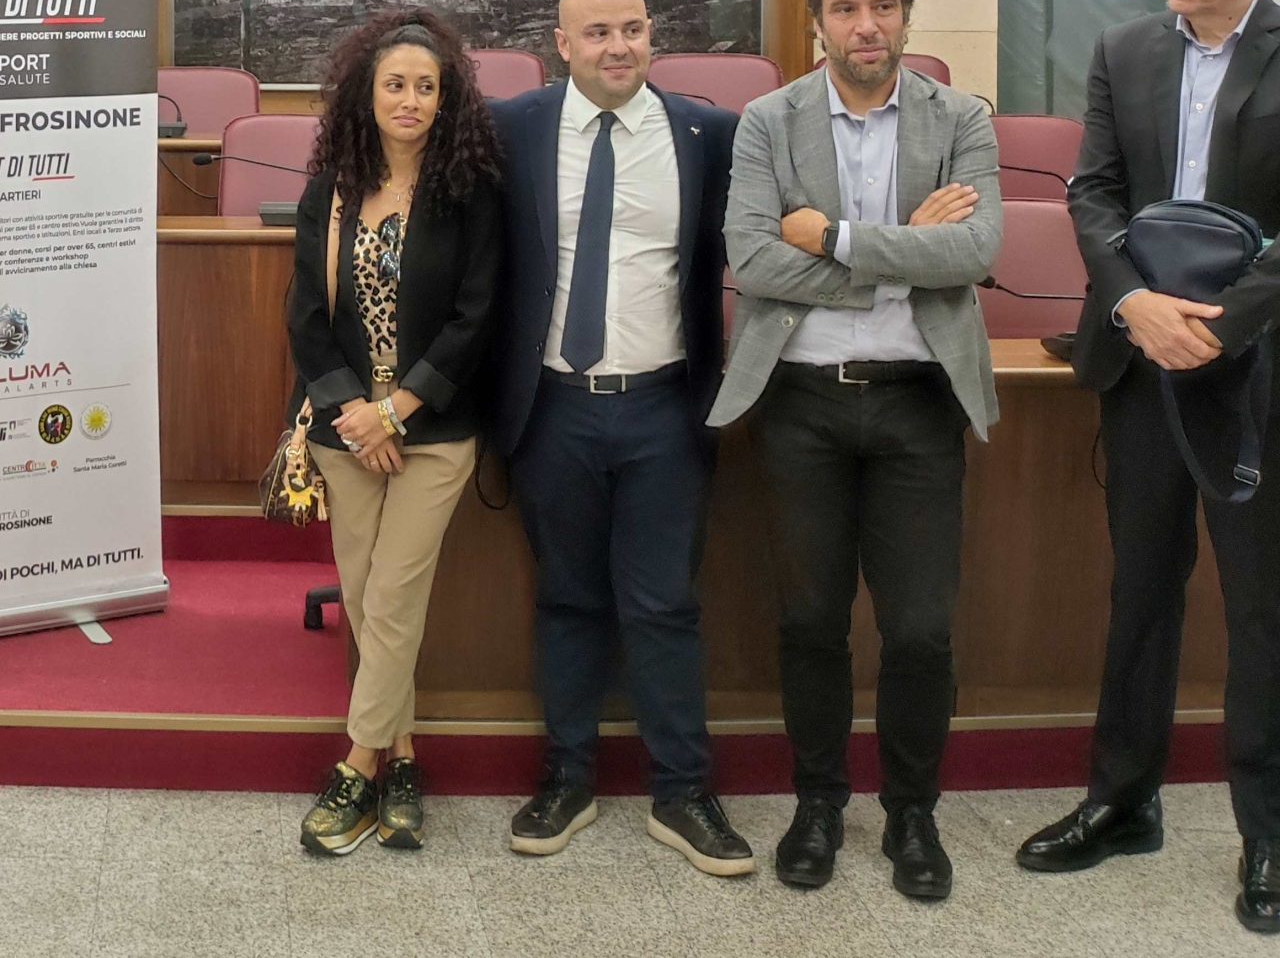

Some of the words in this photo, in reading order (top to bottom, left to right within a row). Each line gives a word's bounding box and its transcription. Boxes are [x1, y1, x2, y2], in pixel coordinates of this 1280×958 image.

[20, 31, 63, 41] PROGETTI
[65, 30, 106, 40] SPORTIVI
[108, 30, 113, 39] E
[114, 29, 147, 39] SOCIALI
[0, 73, 51, 86] SALUTE
[0, 107, 142, 133] FROSINONE
[7, 155, 24, 178] DI
[27, 153, 70, 176] TUTTI
[34, 245, 52, 253] corsi
[53, 245, 66, 253] per
[97, 240, 118, 249] centri
[4, 257, 45, 266] conferenze
[51, 253, 89, 262] workshop
[5, 264, 58, 275] avvicinamento
[20, 509, 30, 519] DI
[10, 560, 58, 580] POCHI,
[61, 557, 84, 571] MA
[86, 553, 101, 567] DI
[103, 547, 144, 564] TUTTI.
